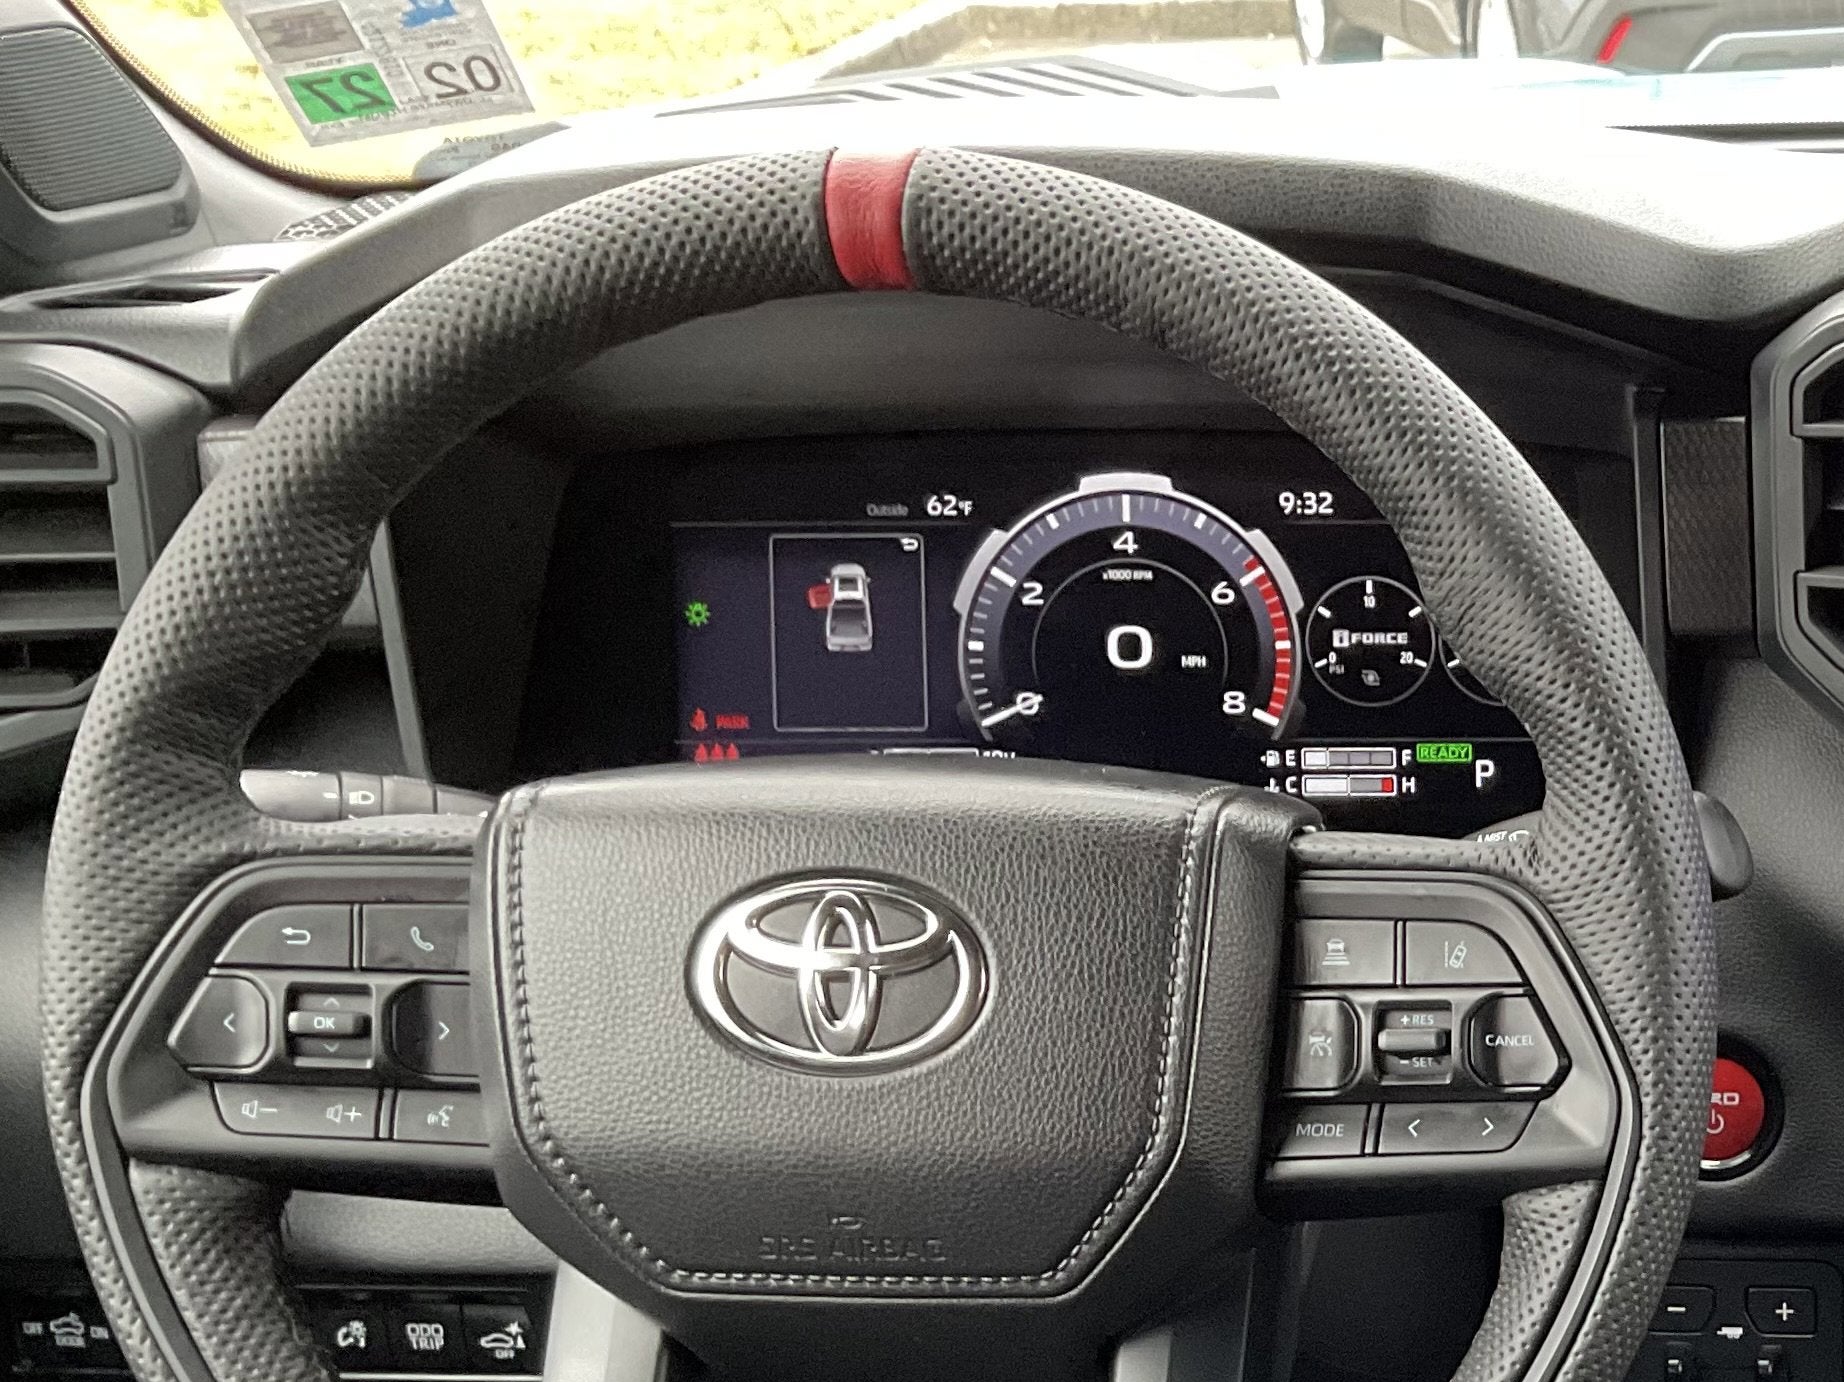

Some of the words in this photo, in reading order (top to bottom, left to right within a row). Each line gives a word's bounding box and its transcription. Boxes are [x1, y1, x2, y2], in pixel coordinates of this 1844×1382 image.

[1278, 491, 1335, 516] 9:32
[1112, 530, 1139, 555] 4
[1020, 581, 1045, 606] 2
[1210, 581, 1236, 606] 6
[1363, 595, 1376, 609] 10
[1106, 625, 1153, 670] 0
[1400, 651, 1414, 665] 20
[1222, 690, 1247, 716] 8
[1285, 751, 1296, 767] E
[1402, 750, 1412, 767] F
[1419, 745, 1470, 762] READY
[1475, 759, 1496, 788] P
[1402, 777, 1416, 794] H
[313, 1017, 336, 1030] OK
[1485, 1033, 1536, 1048] CANCEL
[1711, 1092, 1741, 1106] RD
[1296, 1123, 1345, 1139] MODE
